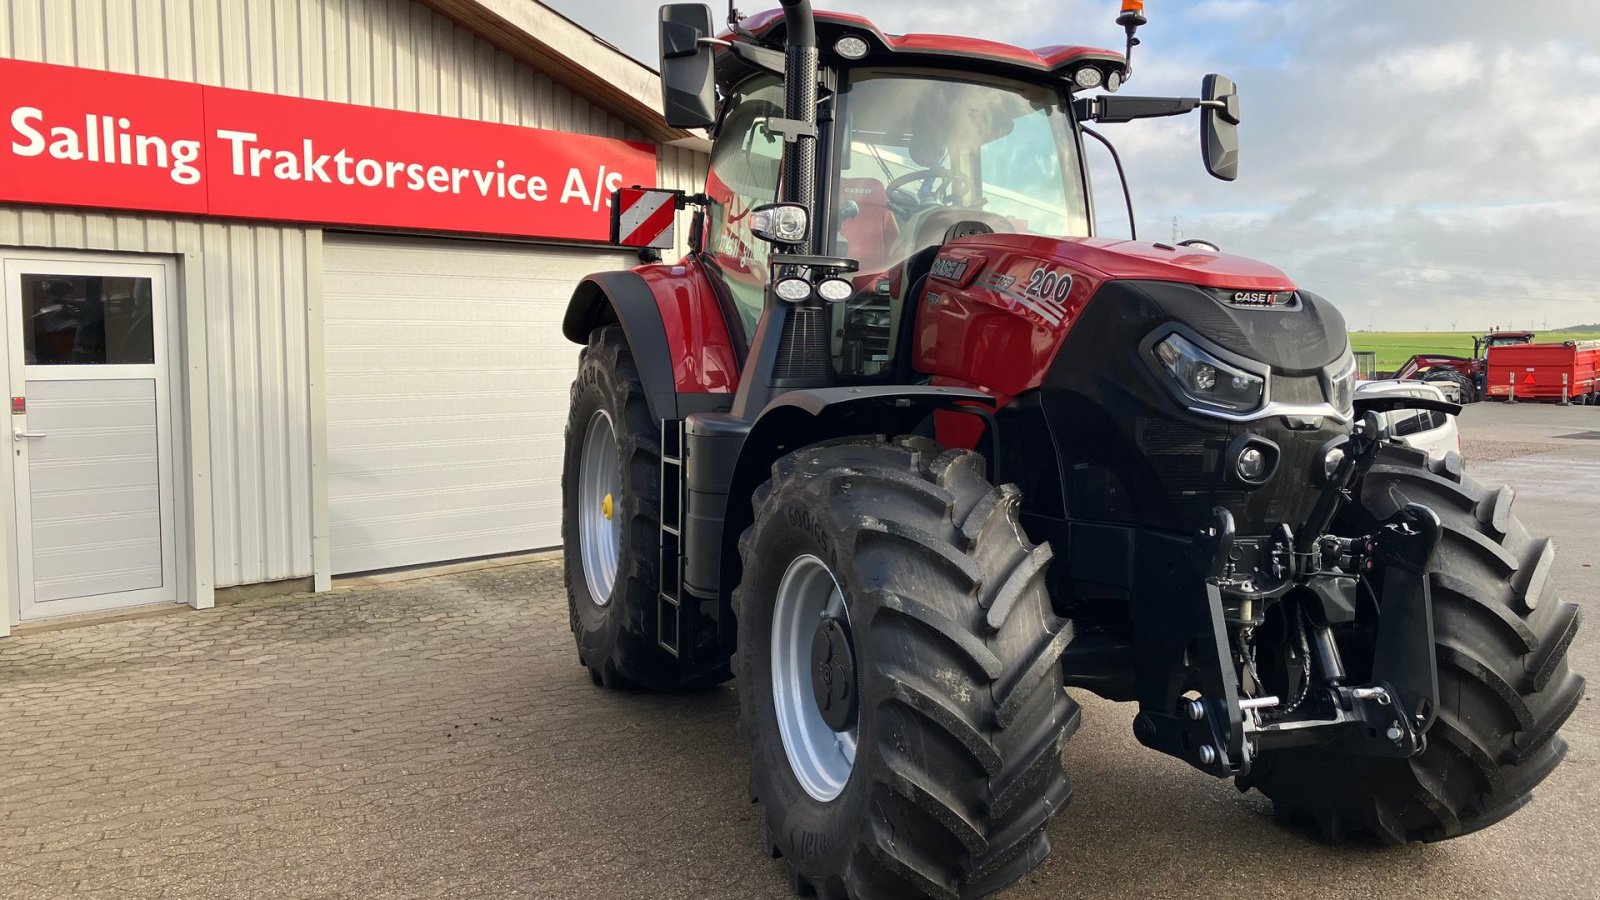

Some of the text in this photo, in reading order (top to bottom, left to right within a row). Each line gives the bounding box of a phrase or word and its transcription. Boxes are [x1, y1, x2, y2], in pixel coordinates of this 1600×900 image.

[11, 106, 622, 212] Salling Traktorservice A/S
[1024, 268, 1072, 304] 200
[1234, 292, 1266, 302] CASE
